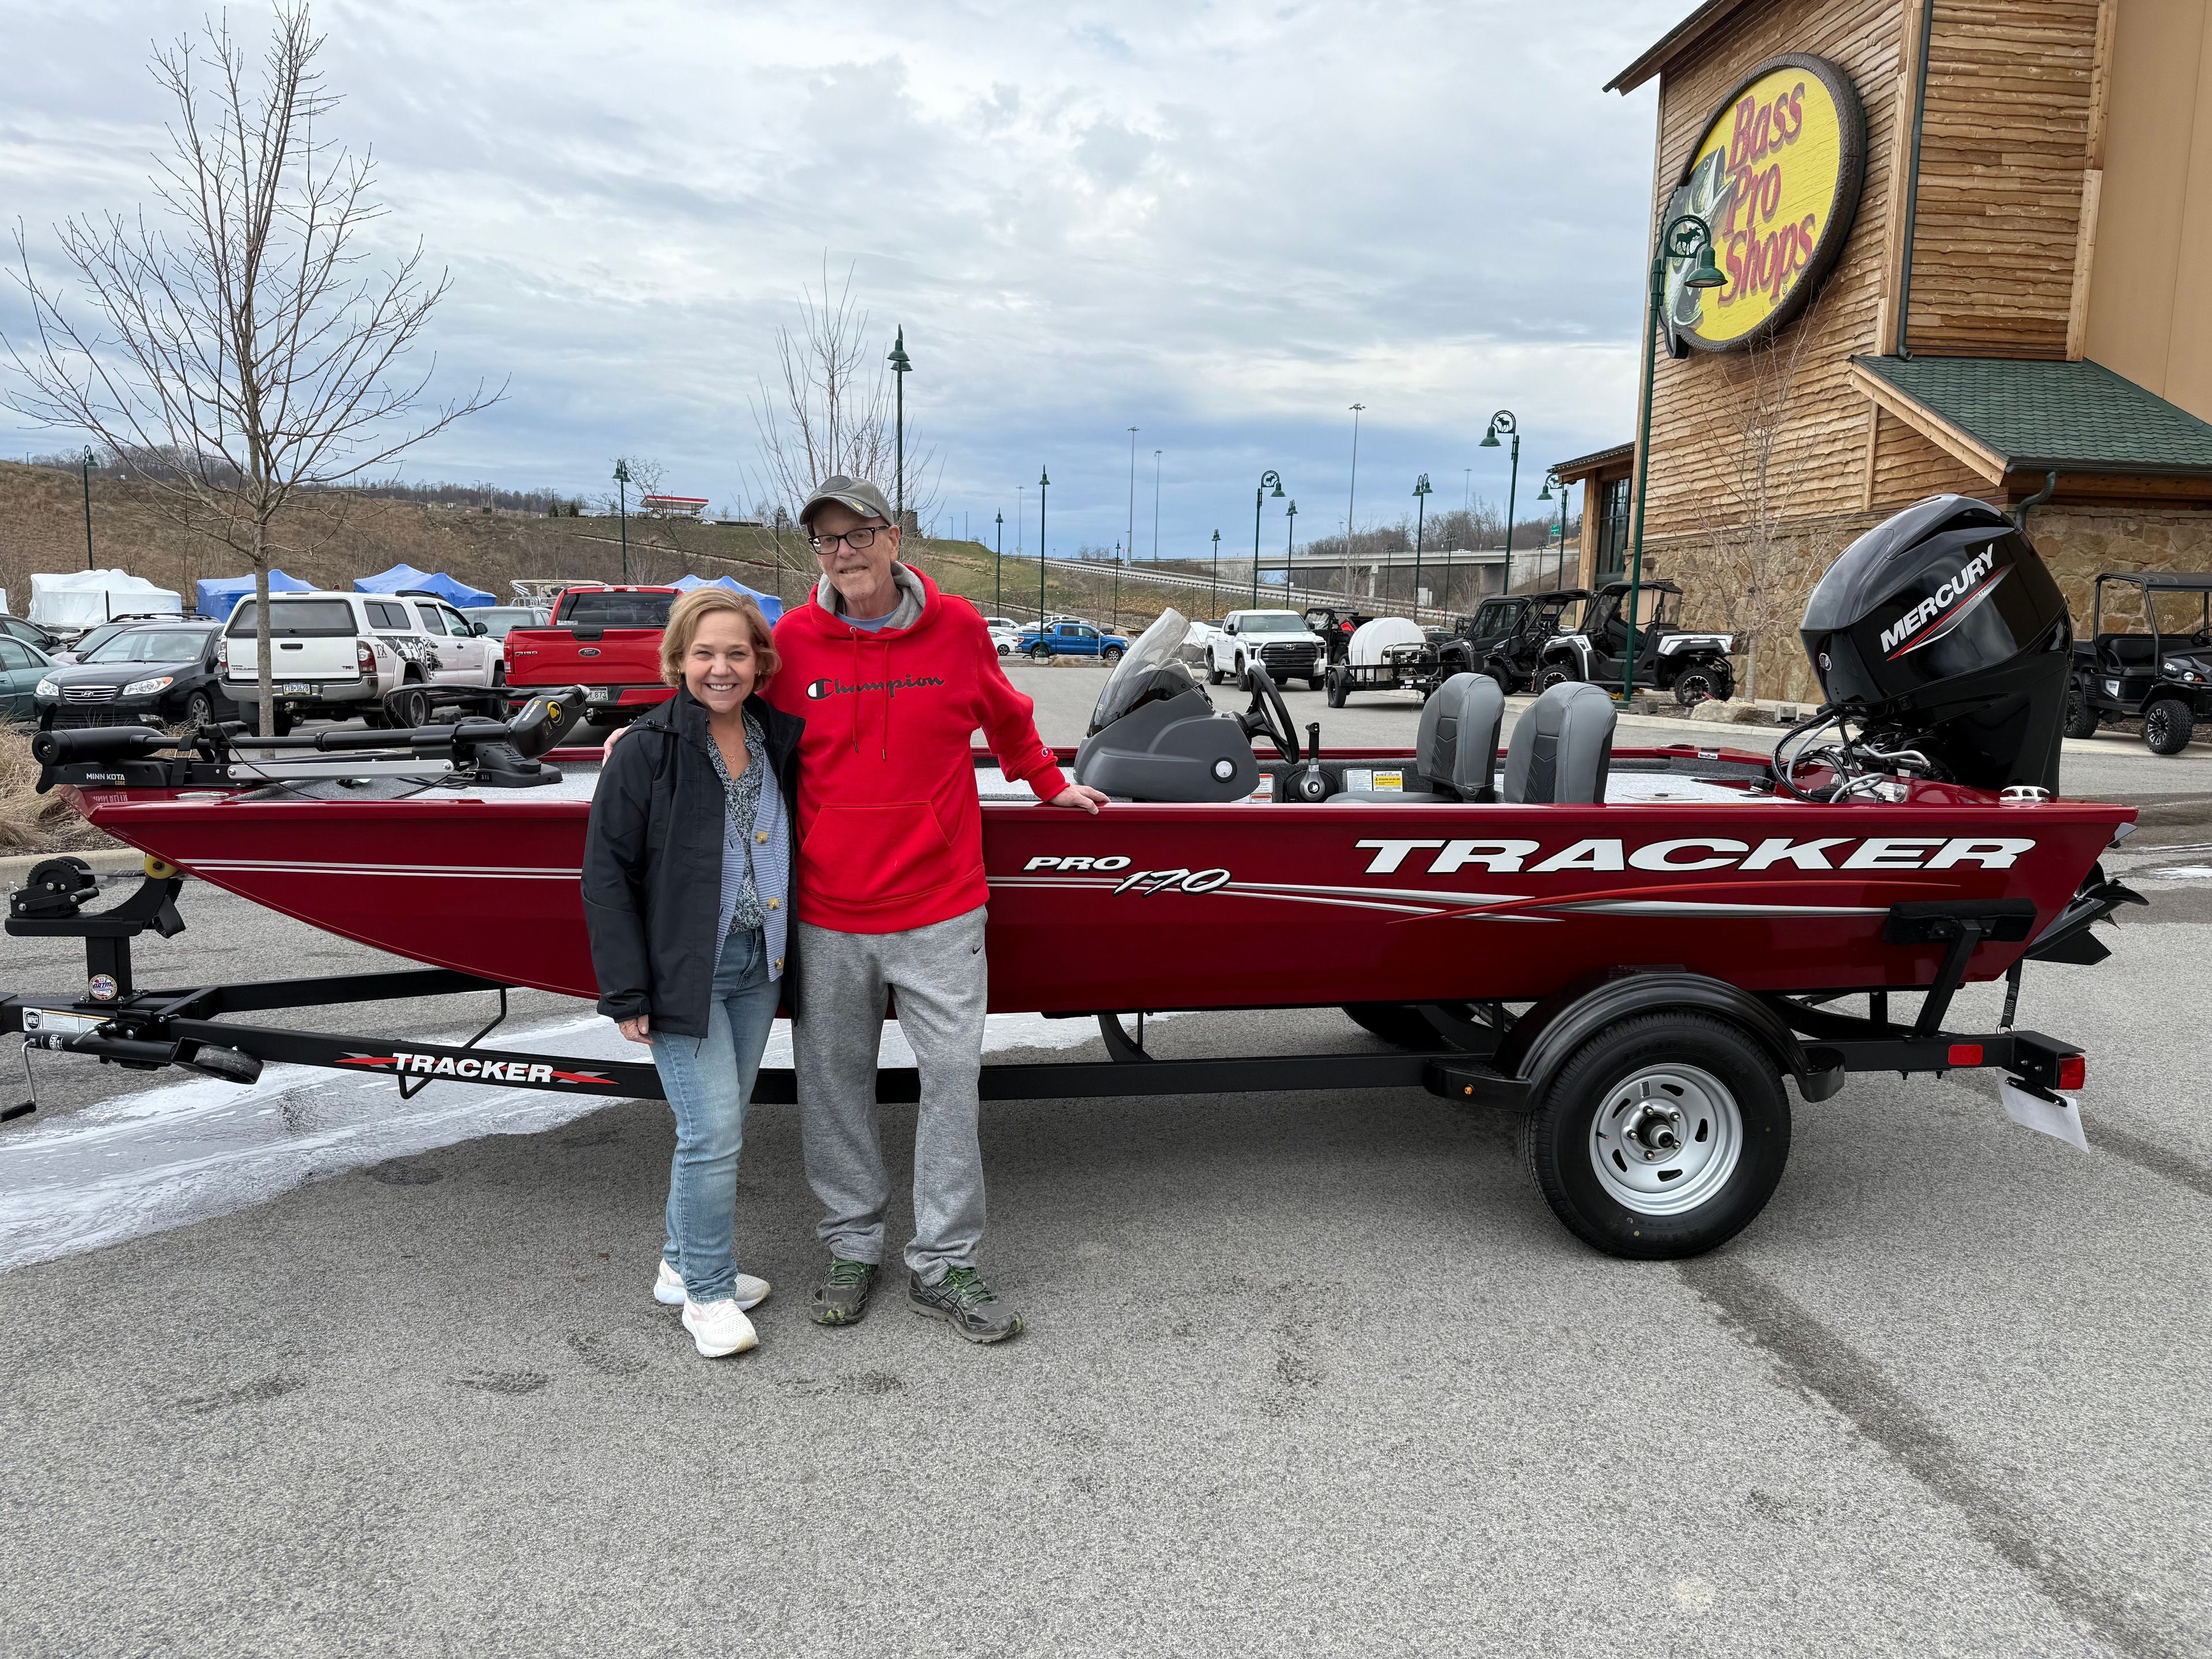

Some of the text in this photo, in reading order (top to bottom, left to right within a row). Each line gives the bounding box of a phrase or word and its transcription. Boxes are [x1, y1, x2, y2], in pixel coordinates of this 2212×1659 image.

[1726, 82, 1805, 173] Bass
[1722, 164, 1781, 240] Pro
[1715, 213, 1816, 303] Shops
[1880, 543, 1993, 653] MERCURY
[806, 674, 945, 700] Champion
[1023, 856, 1131, 870] PRO
[1355, 838, 2037, 873] TRACKER
[1113, 868, 1230, 896] 170
[392, 1052, 554, 1084] TRACKER
